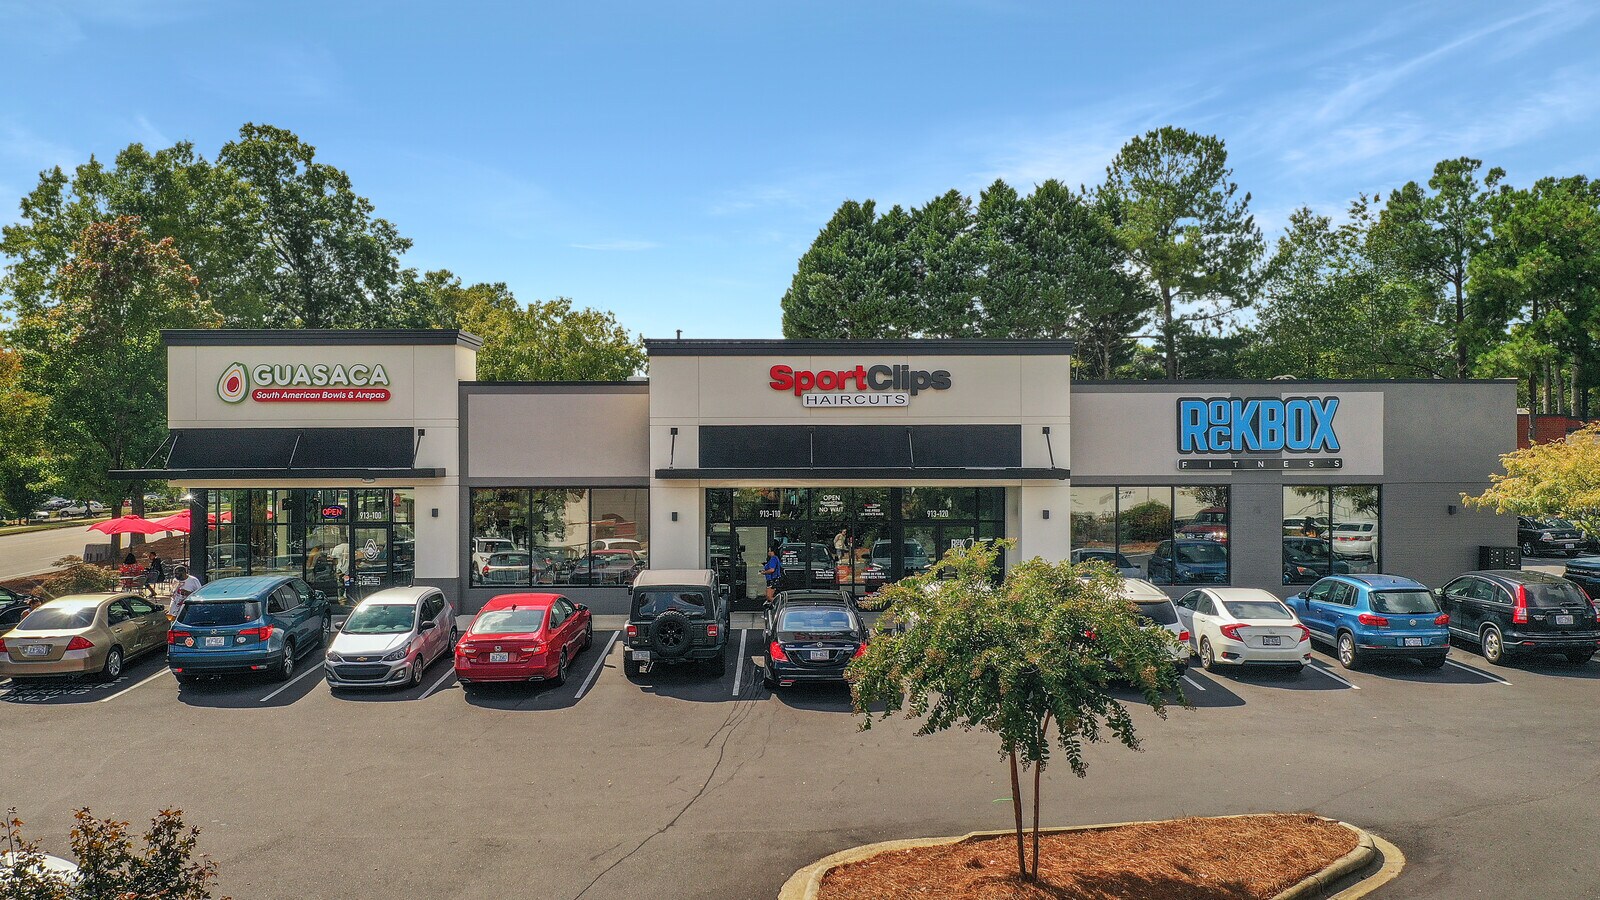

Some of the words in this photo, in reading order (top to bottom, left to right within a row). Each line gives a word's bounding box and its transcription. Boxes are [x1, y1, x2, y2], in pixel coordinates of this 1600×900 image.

[252, 364, 390, 387] GUASACA
[769, 364, 952, 397] SportClips
[256, 391, 280, 399] South
[281, 391, 321, 399] American
[322, 391, 346, 399] Bowls
[347, 391, 354, 399] &
[356, 391, 386, 400] Arepas
[806, 395, 906, 405] HAIRCUTS
[322, 508, 342, 516] OPEN
[359, 511, 382, 519] 913-100
[759, 509, 781, 518] 913-110
[926, 509, 949, 518] 913-120
